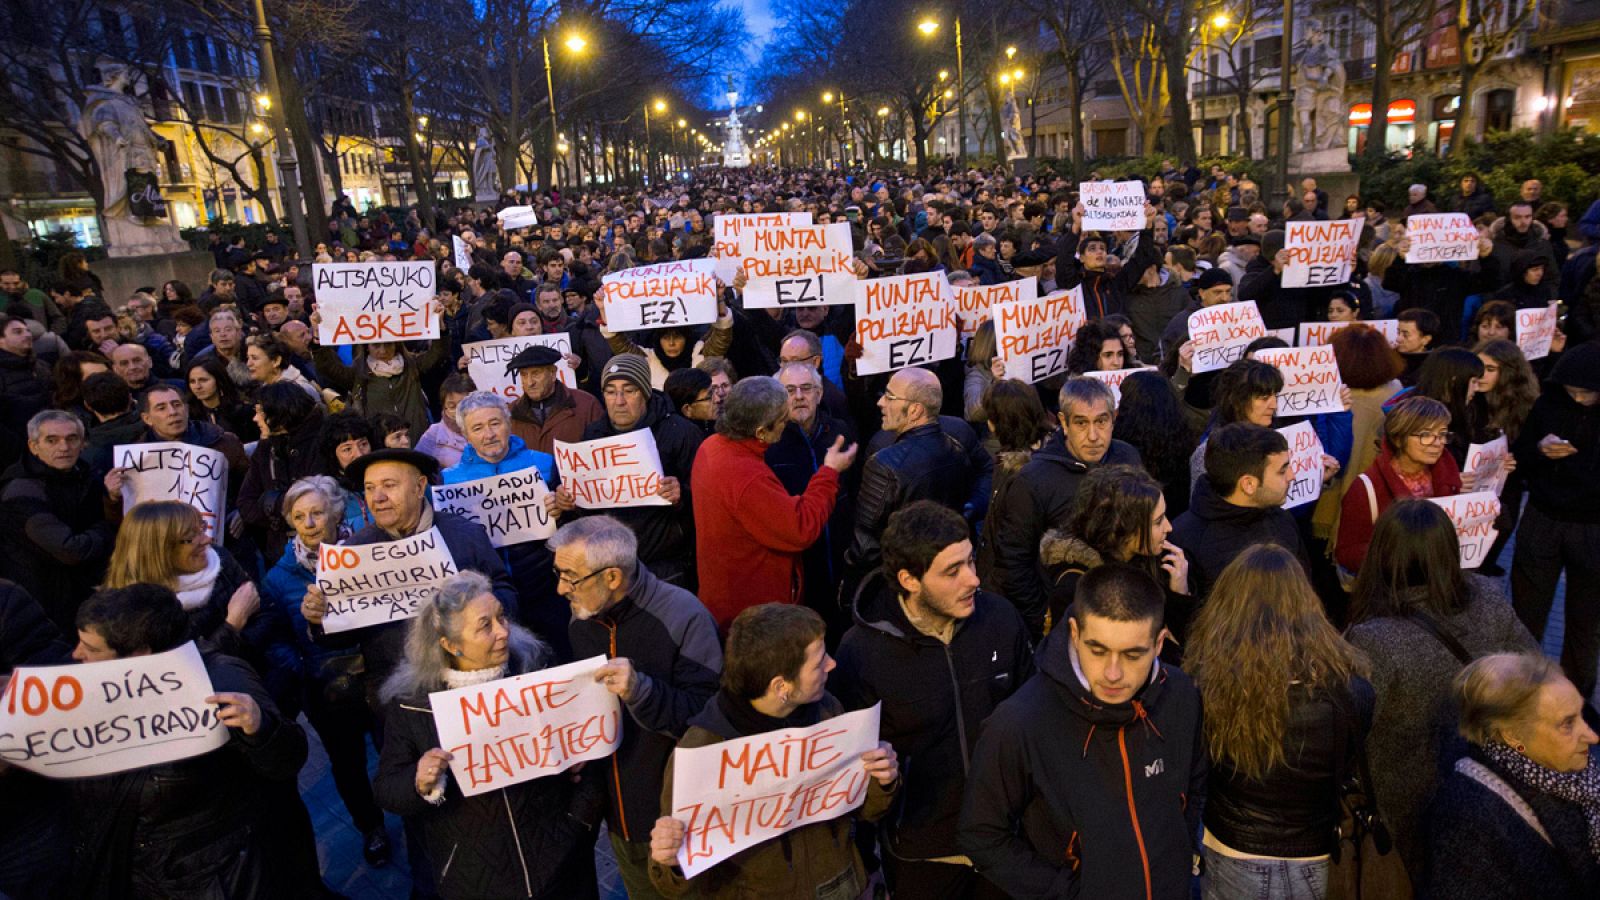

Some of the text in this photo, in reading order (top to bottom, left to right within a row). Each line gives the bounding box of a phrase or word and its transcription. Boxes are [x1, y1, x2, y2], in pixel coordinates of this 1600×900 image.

[1086, 196, 1100, 207] de
[317, 266, 433, 291] ALTSASUKO
[775, 274, 825, 304] EZ!
[1306, 263, 1346, 285] EZ!
[361, 289, 420, 312] 11-K
[639, 296, 689, 326] EZ!
[331, 302, 432, 344] ASKE!
[889, 332, 934, 369] EZ!
[555, 443, 640, 473] MAITE
[434, 471, 544, 502] JOKIN, ADUR
[481, 488, 534, 510] OIHAN
[319, 532, 436, 572] 100 EGUN
[318, 561, 456, 597] BAHITURIK
[4, 668, 85, 717] 100
[101, 669, 183, 704] DÍAS
[459, 676, 580, 736] MAITE
[0, 706, 221, 761] SECUESTRADOS
[450, 711, 619, 789] ZAITUZTEGU
[718, 729, 849, 790] MAITE
[677, 769, 867, 866] ZAITUZTEGU
